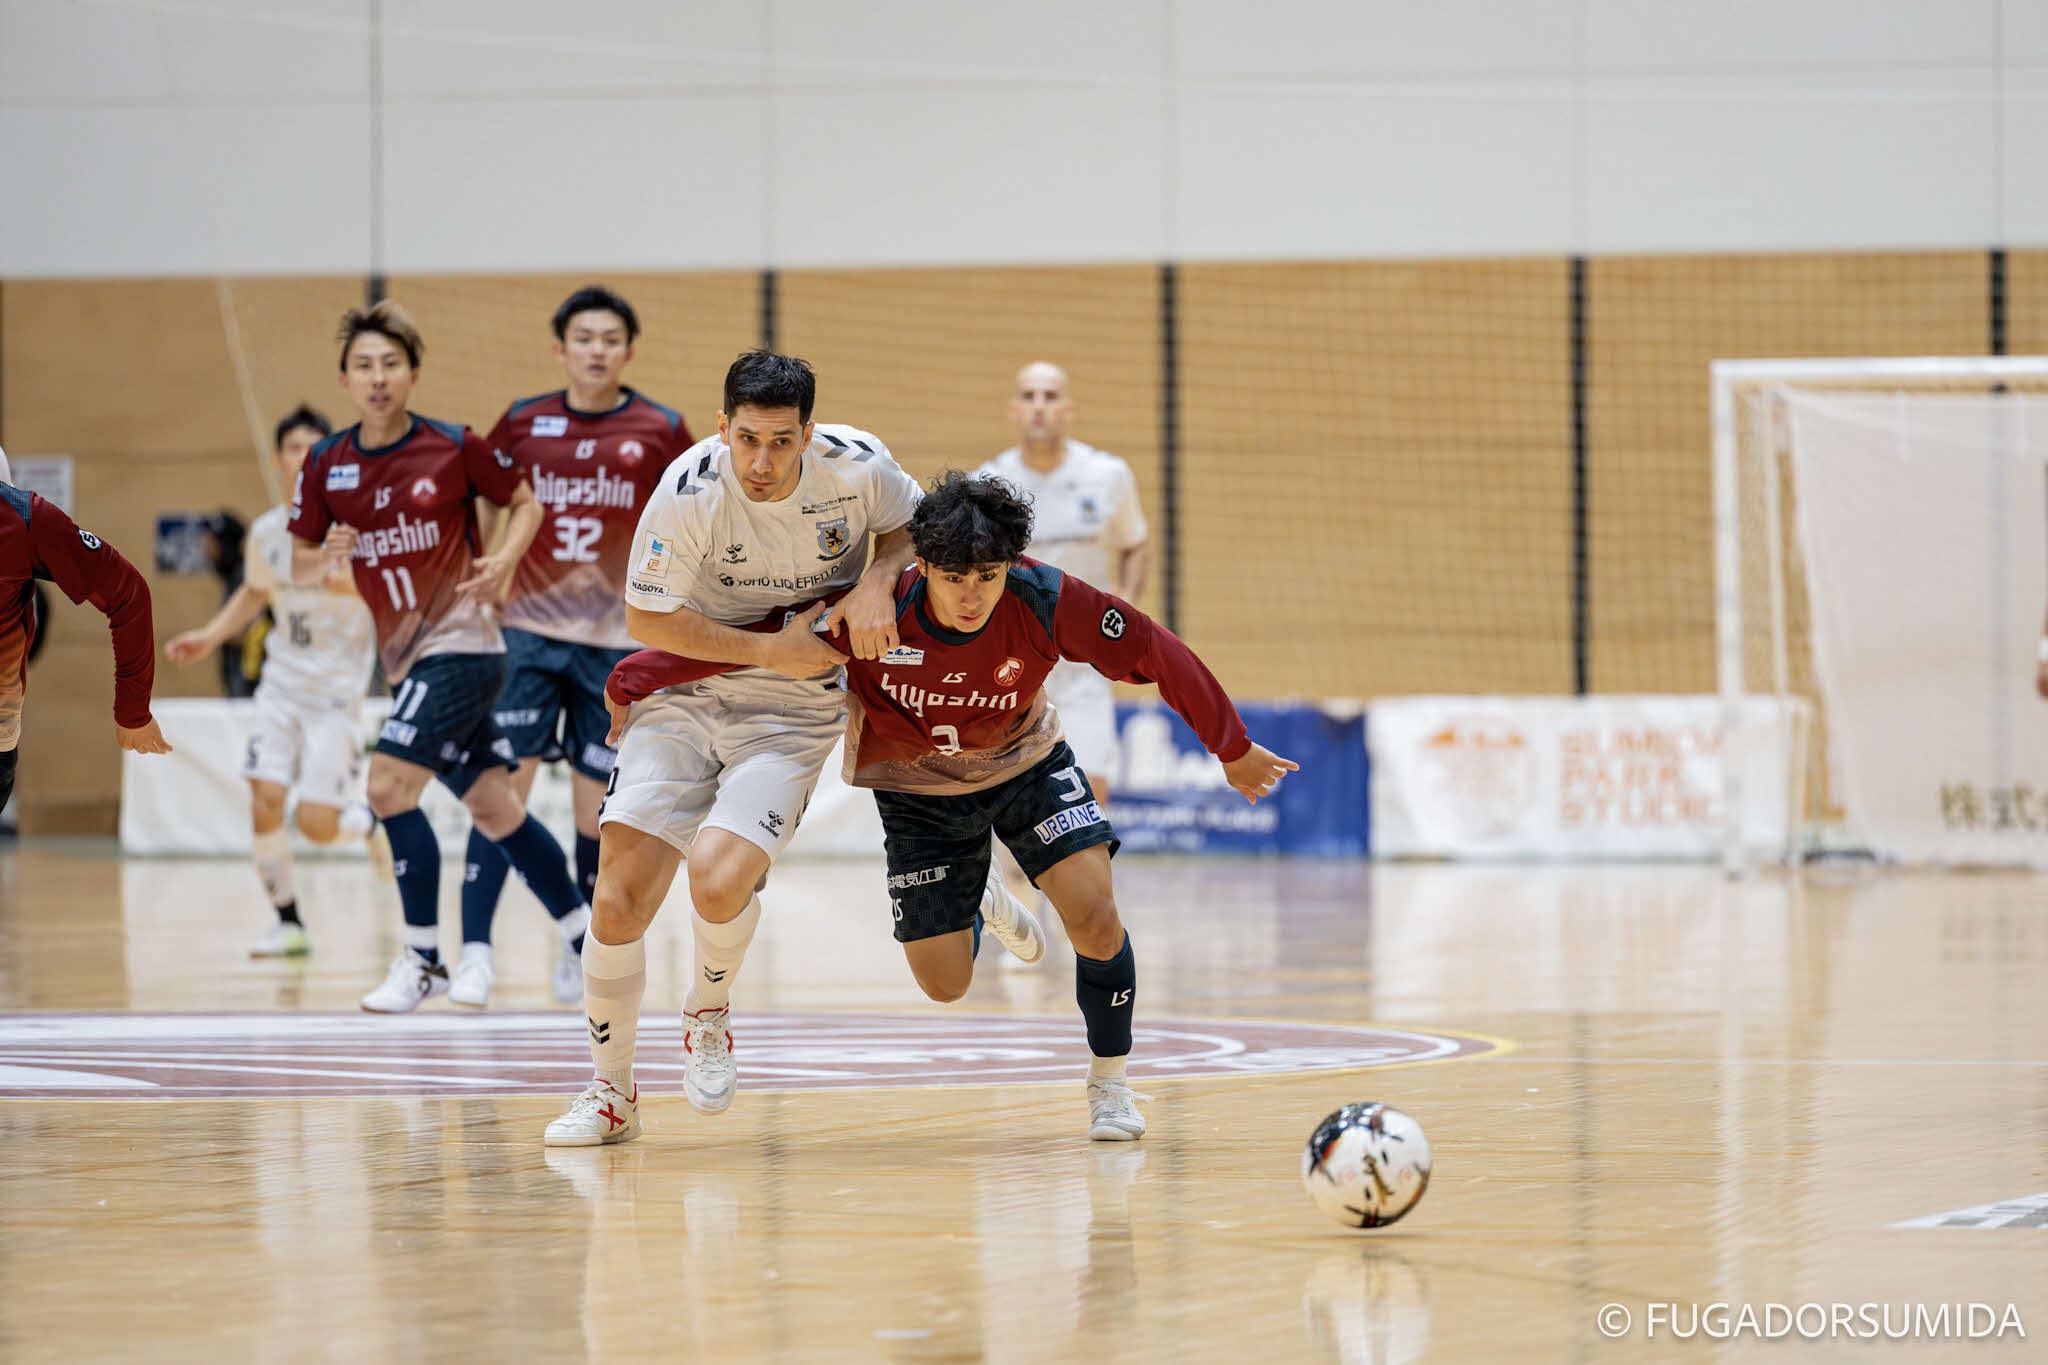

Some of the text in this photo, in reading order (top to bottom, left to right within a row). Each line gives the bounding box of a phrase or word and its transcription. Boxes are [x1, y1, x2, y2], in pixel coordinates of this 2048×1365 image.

[531, 463, 636, 514] higashin
[352, 511, 441, 568] igashin
[552, 516, 604, 562] 32
[381, 566, 418, 612] 11
[632, 580, 664, 595] NAGOYA
[393, 677, 429, 720] 11
[941, 672, 967, 684] LS
[1111, 988, 1132, 1008] LS
